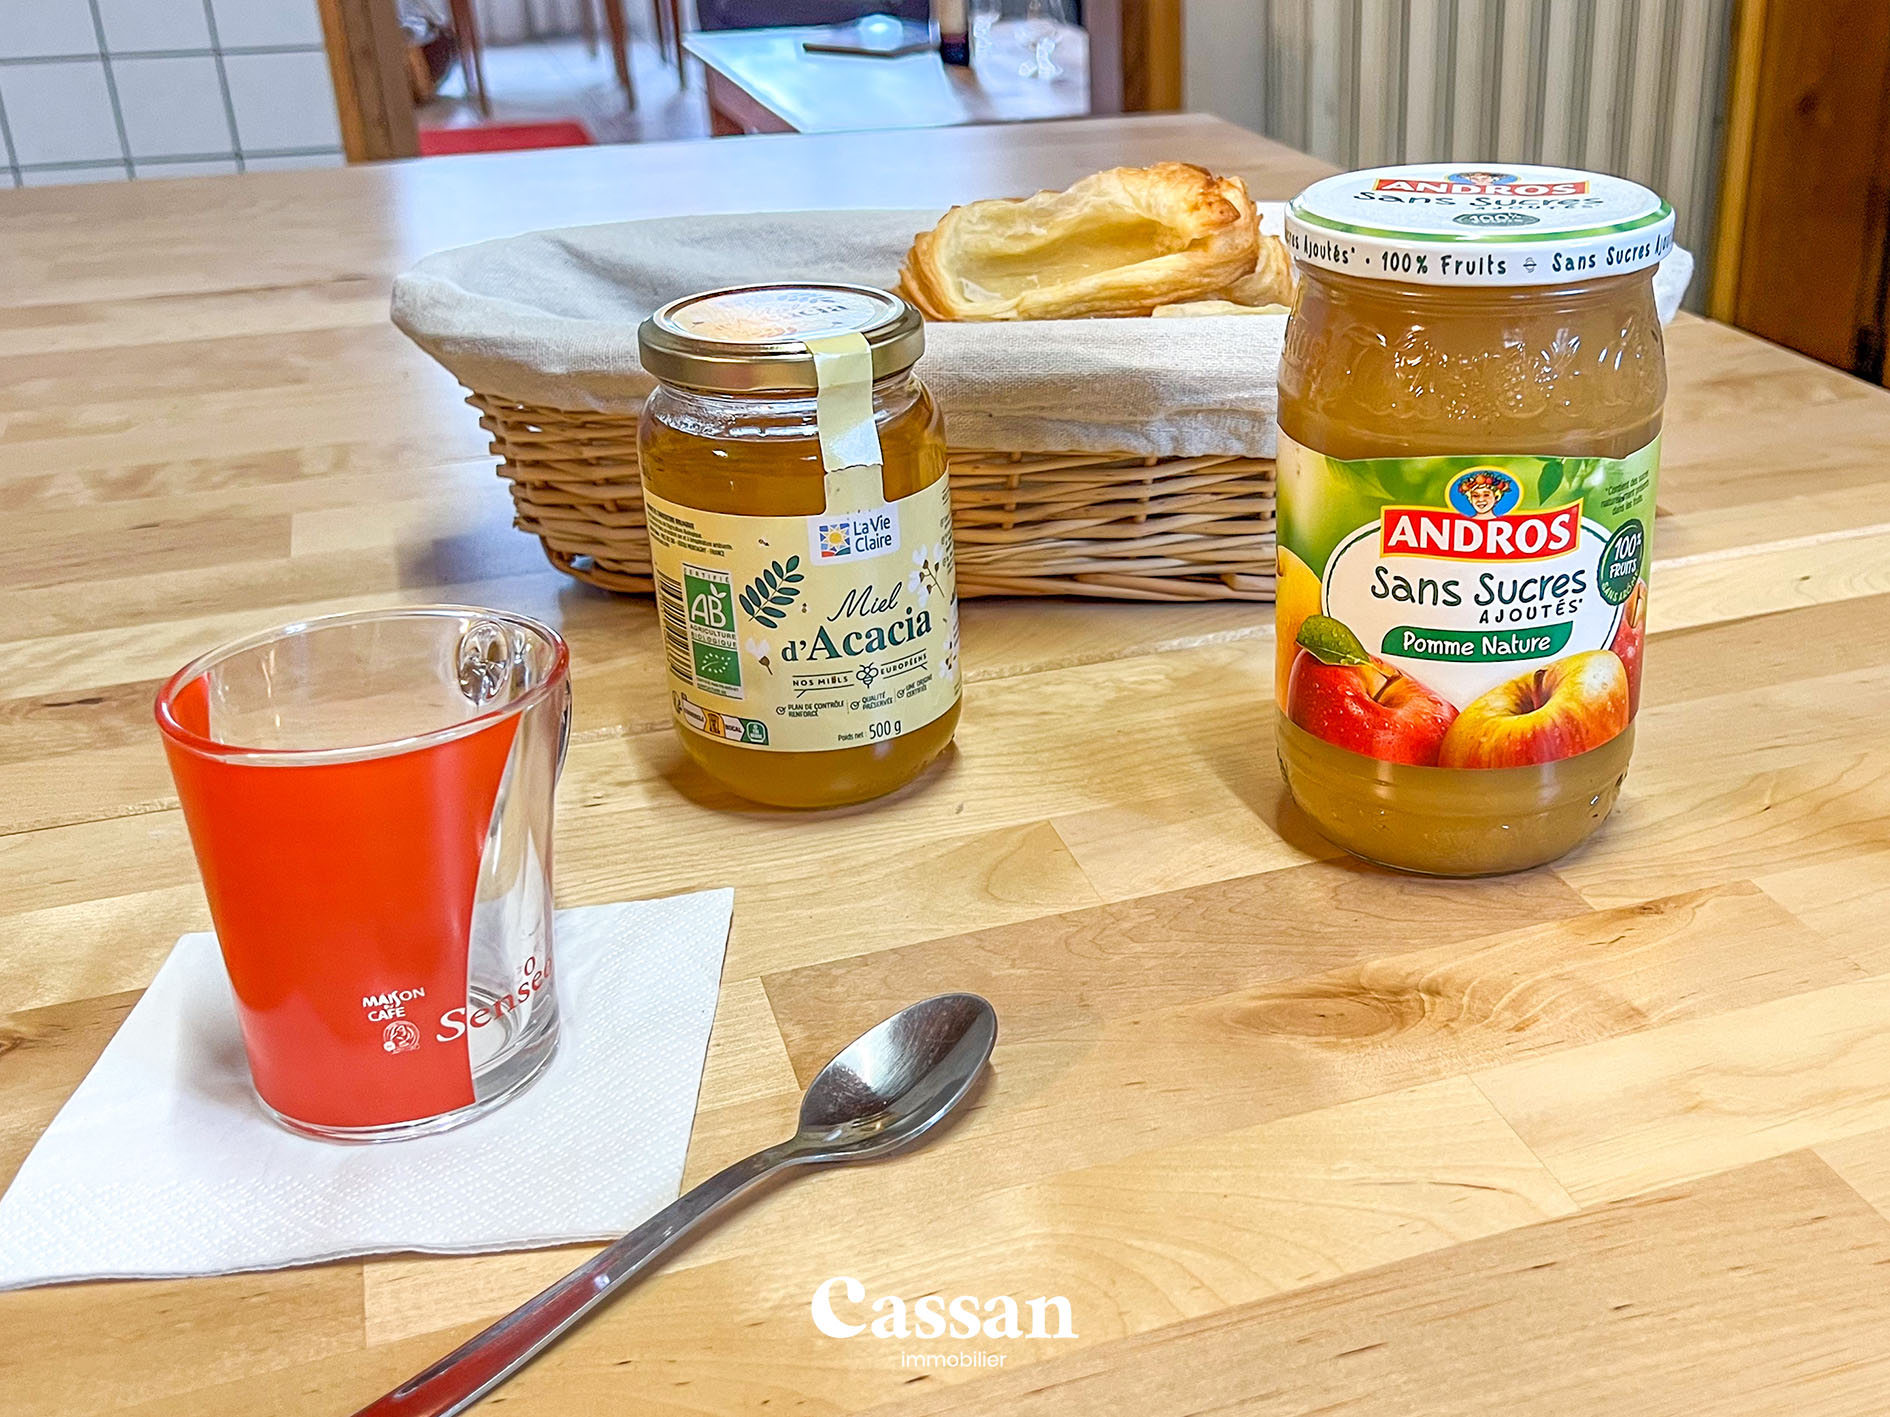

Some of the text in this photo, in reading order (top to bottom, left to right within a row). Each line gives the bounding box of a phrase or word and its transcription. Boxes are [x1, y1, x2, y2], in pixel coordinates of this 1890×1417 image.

[1353, 191, 1604, 207] Sans Sucres
[1381, 181, 1577, 197] ANDROS
[1381, 250, 1429, 275] 100%
[1441, 253, 1508, 276] Fruits
[1551, 252, 1597, 273] Sans
[1606, 245, 1651, 266] Sucres
[853, 514, 892, 537] La Vie
[1388, 513, 1571, 555] ANDROS
[855, 532, 893, 553] Claire
[1609, 558, 1638, 579] FRUITS
[1371, 566, 1587, 607] Sans Sucres
[1601, 581, 1620, 602] SANS
[690, 593, 727, 629] AB
[826, 581, 903, 623] Miel
[690, 623, 737, 640] AGRICULTURE
[691, 630, 738, 648] BIOLOGIQUE
[781, 606, 933, 662] d'Acacia
[1402, 630, 1551, 656] Pomme Nature
[880, 652, 928, 675] EUROPÉENS
[792, 679, 815, 688] NOS
[804, 703, 813, 711] DE
[854, 731, 864, 739] net
[868, 720, 892, 740] 500
[894, 719, 902, 736] g
[362, 986, 425, 1008] MAISON
